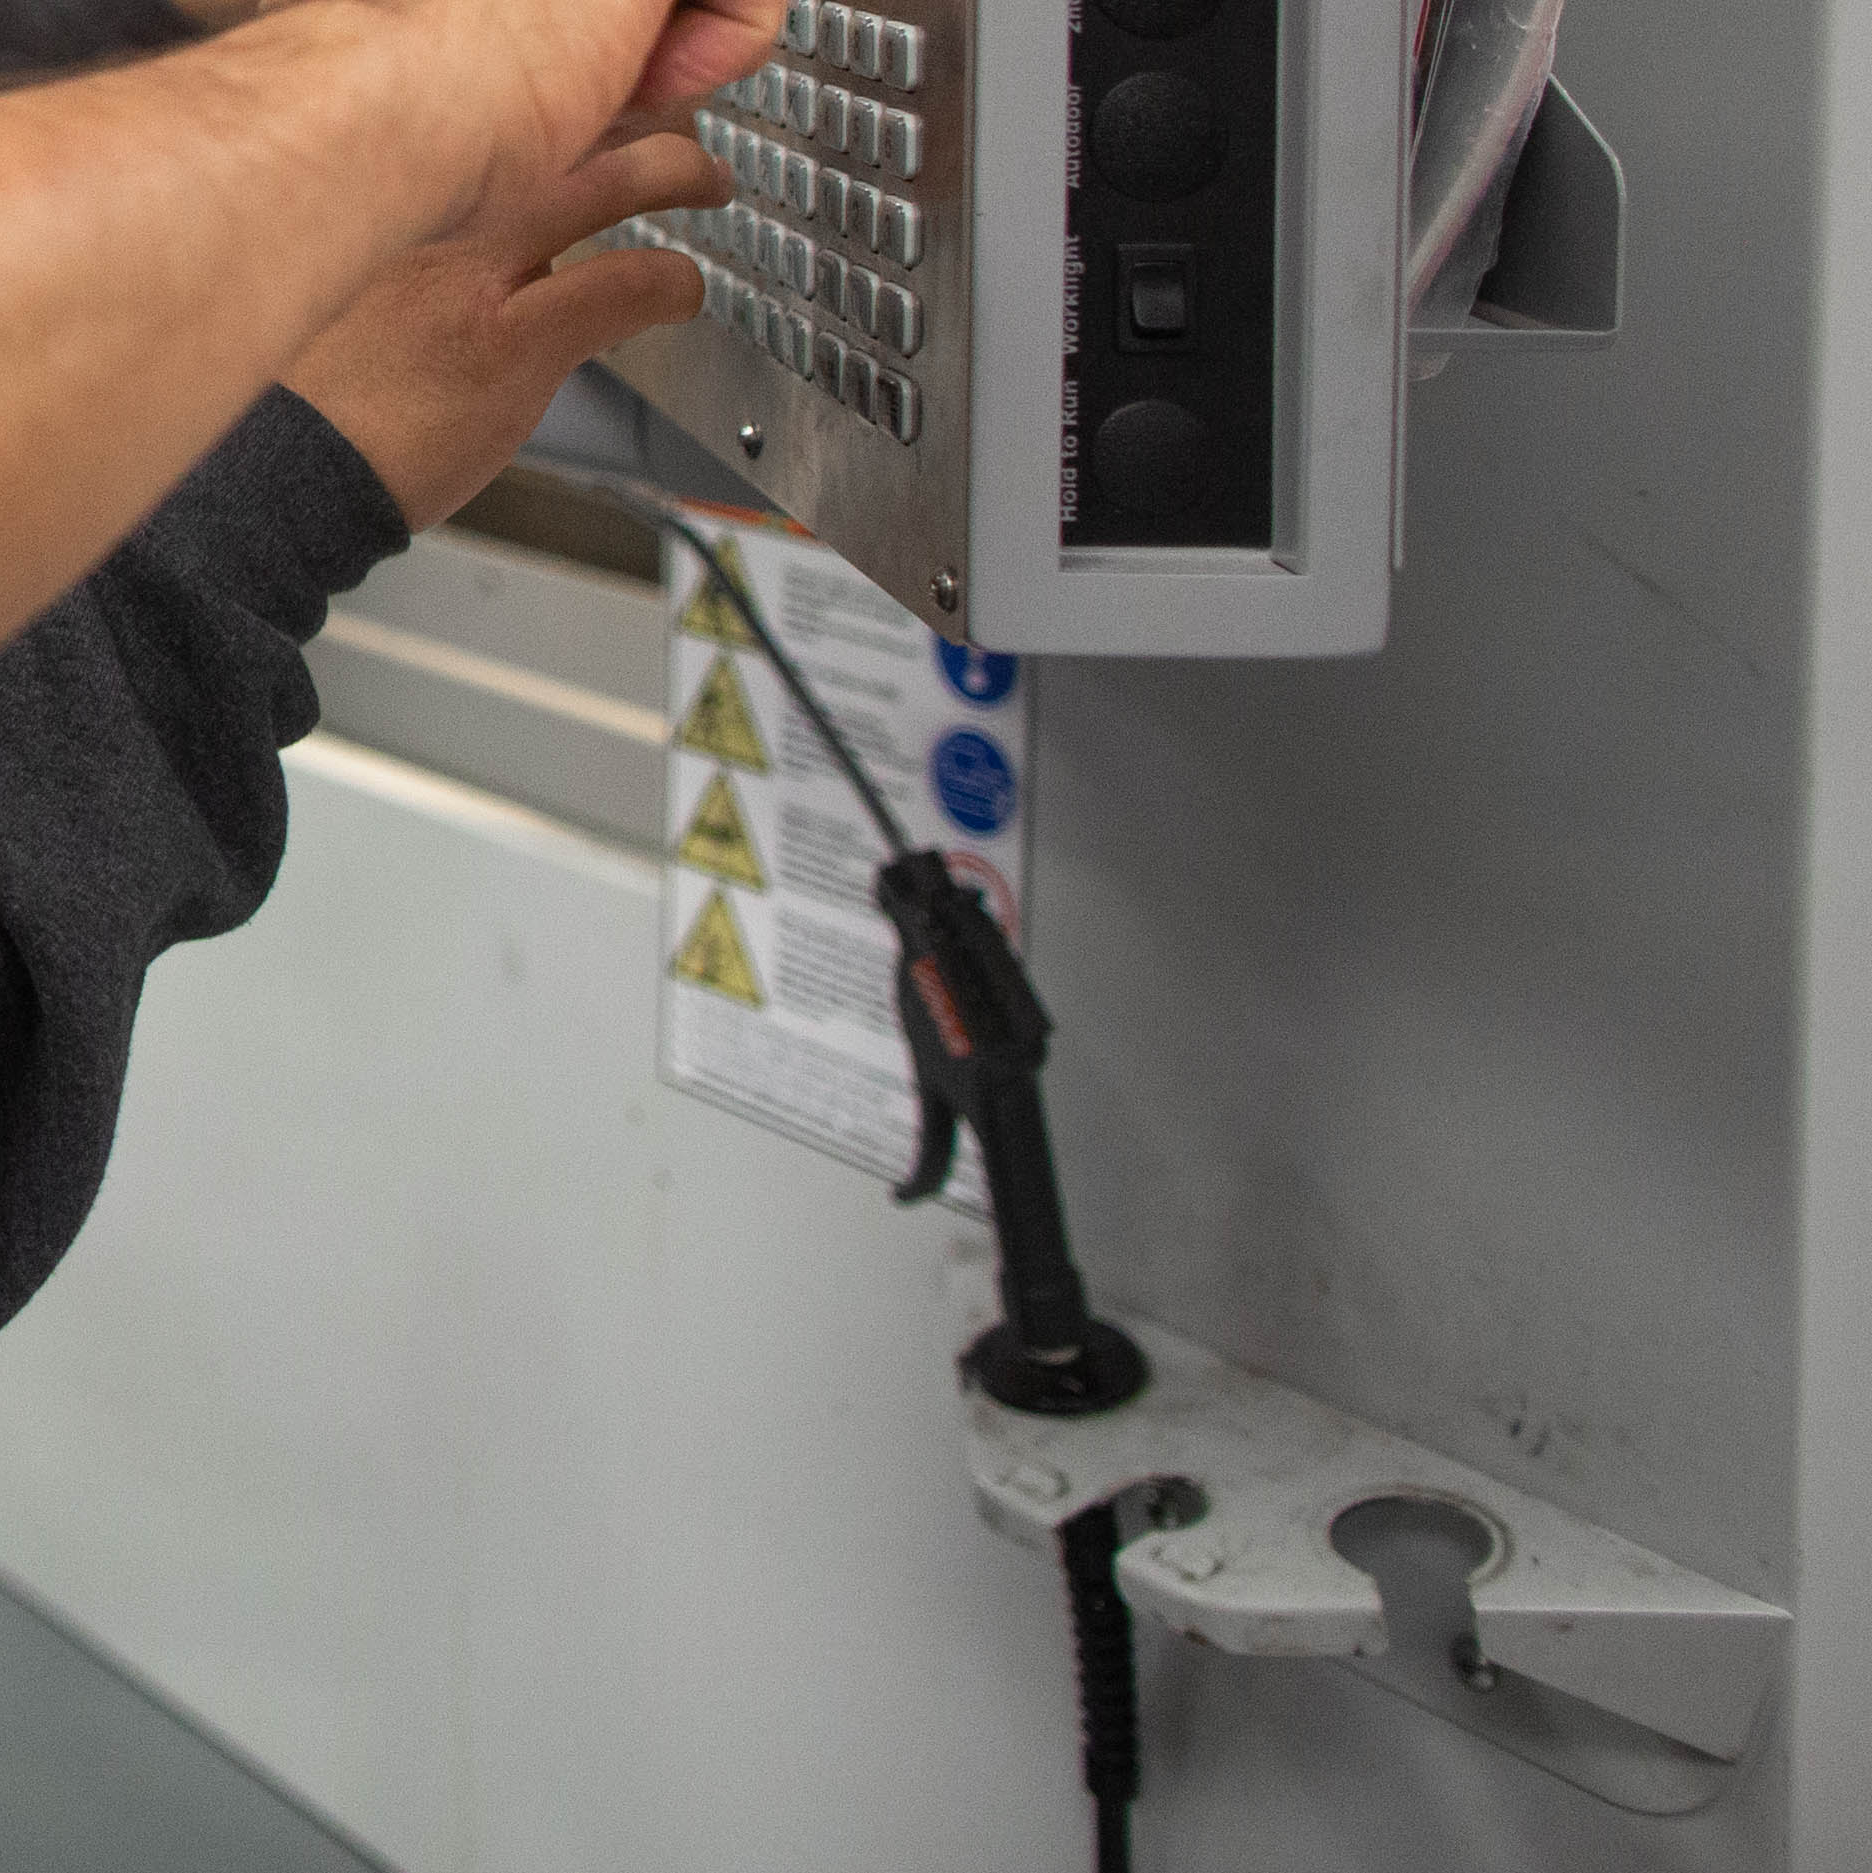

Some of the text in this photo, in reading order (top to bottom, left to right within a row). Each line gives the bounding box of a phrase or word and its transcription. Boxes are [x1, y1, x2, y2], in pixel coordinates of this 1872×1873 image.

[1062, 234, 1086, 355] Worklight
[1061, 380, 1079, 522] Hold to Run
